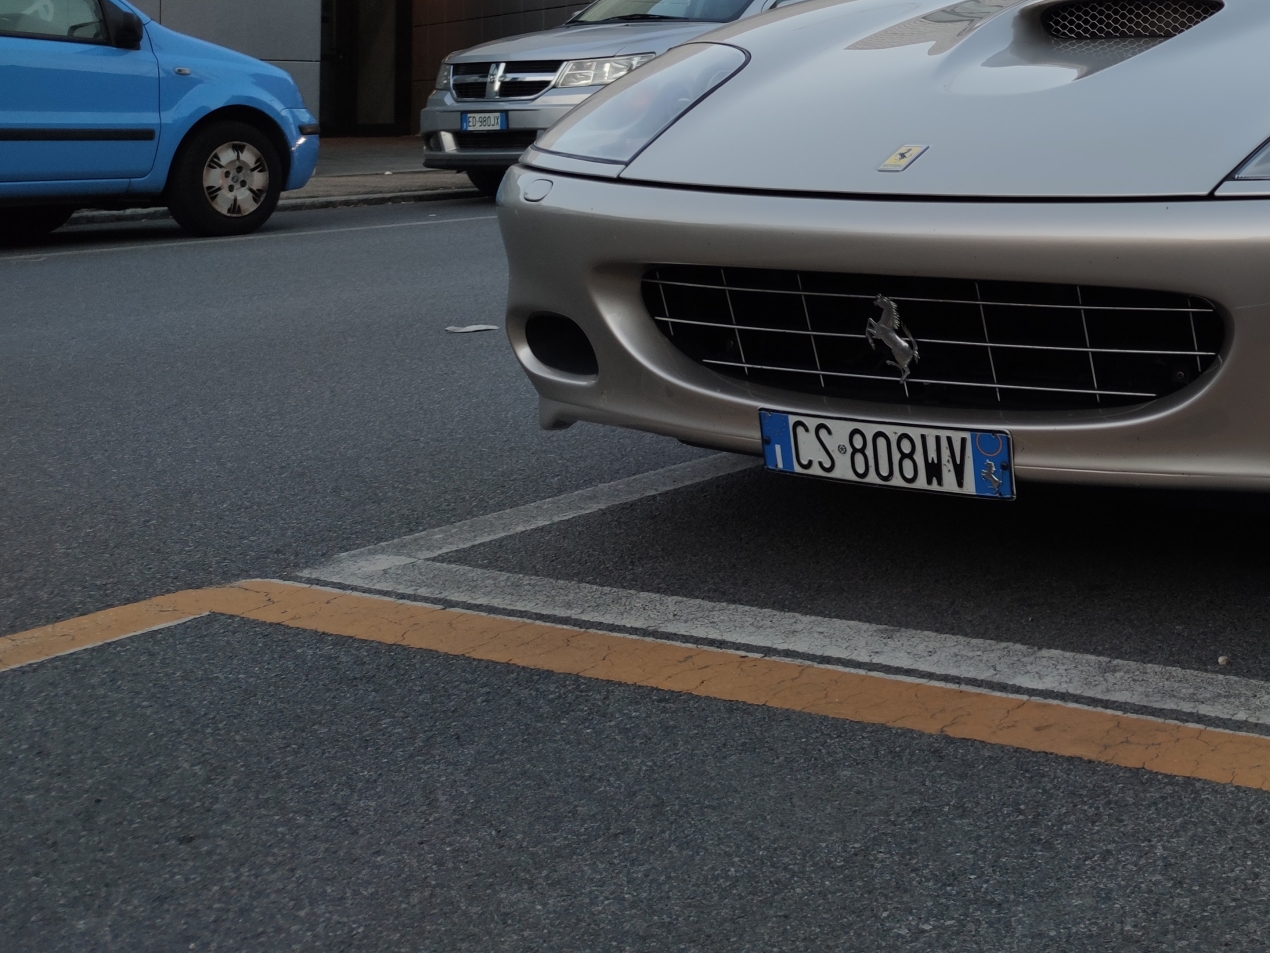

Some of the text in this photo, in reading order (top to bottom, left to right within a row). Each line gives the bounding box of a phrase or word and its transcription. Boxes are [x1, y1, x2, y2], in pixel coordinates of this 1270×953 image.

[468, 116, 477, 127] ED
[791, 420, 836, 473] CS
[848, 428, 968, 489] 808WV
